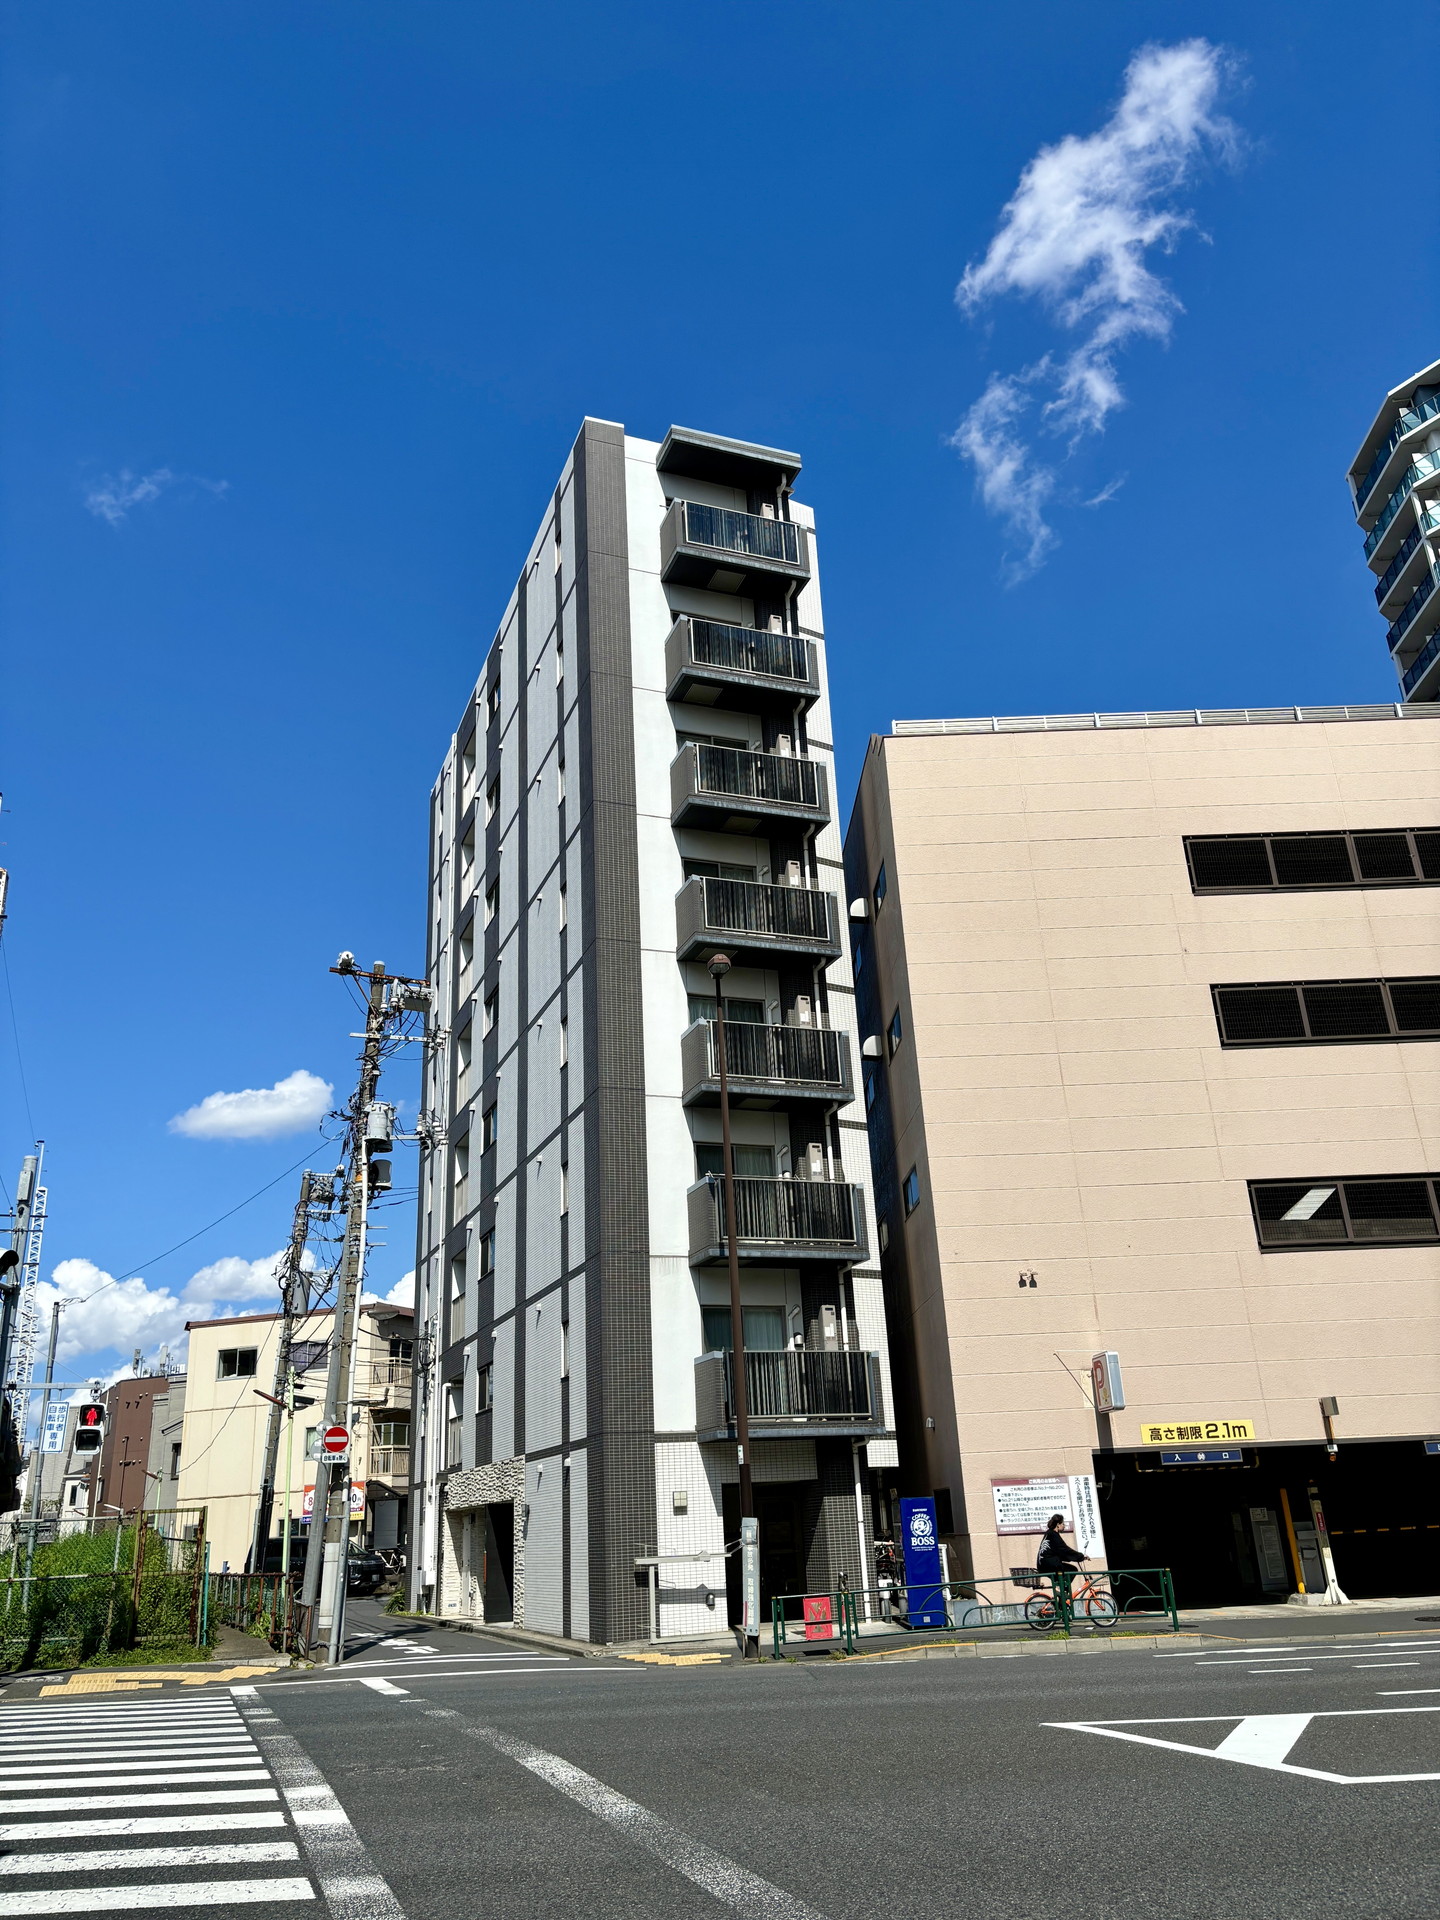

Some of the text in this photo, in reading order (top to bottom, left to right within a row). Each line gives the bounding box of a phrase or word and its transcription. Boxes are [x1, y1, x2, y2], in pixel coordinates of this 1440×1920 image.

[47, 1405, 57, 1431] 自転車
[56, 1405, 66, 1431] 歩行者
[48, 1432, 57, 1449] 専用
[911, 1536, 935, 1546] BOSS
